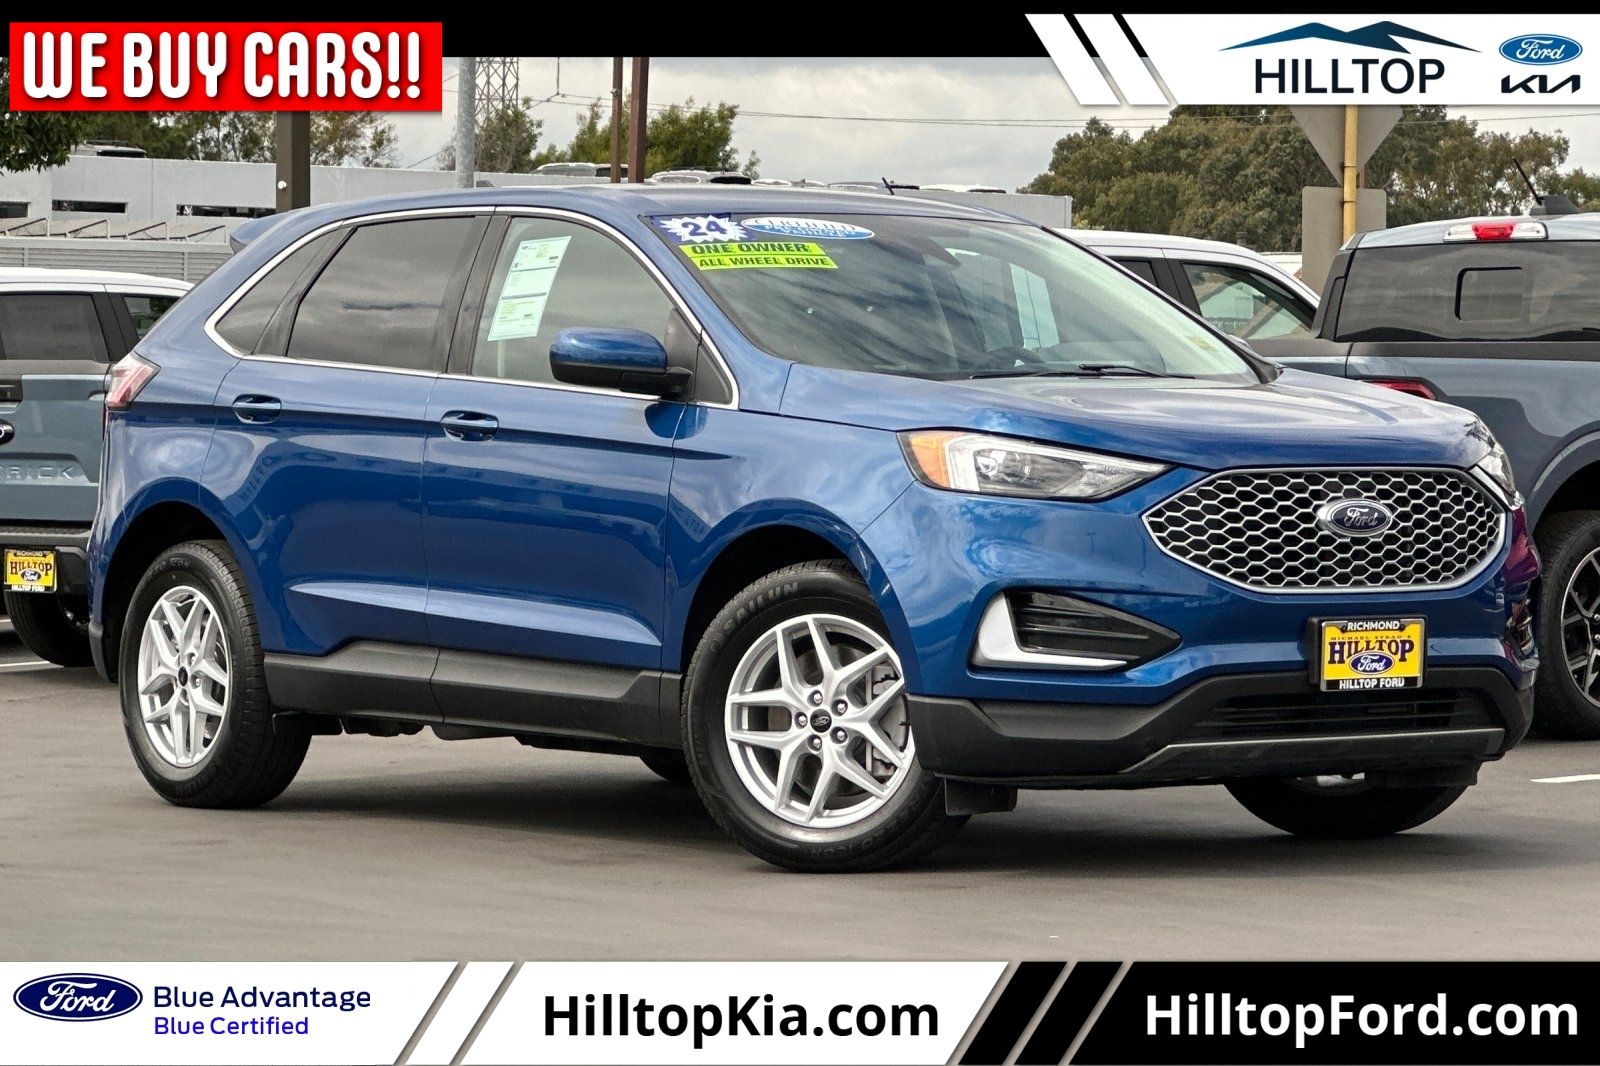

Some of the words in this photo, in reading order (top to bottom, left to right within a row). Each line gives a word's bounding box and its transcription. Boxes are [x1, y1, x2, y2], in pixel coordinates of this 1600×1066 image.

[681, 219, 728, 237] 24
[691, 243, 732, 254] ONE
[737, 243, 811, 254] OWNER
[699, 257, 727, 267] ALL
[728, 256, 782, 266] WHEEL
[786, 257, 832, 266] DRIVE
[1343, 507, 1379, 527] Ford
[10, 561, 53, 577] HILLTOP
[723, 581, 799, 632] SAILUN
[1347, 621, 1400, 631] RICHMOND
[1328, 639, 1415, 665] HILLTOP
[1357, 655, 1387, 671] Ford
[1339, 678, 1377, 690] HILLTOP
[1379, 677, 1405, 688] FORD
